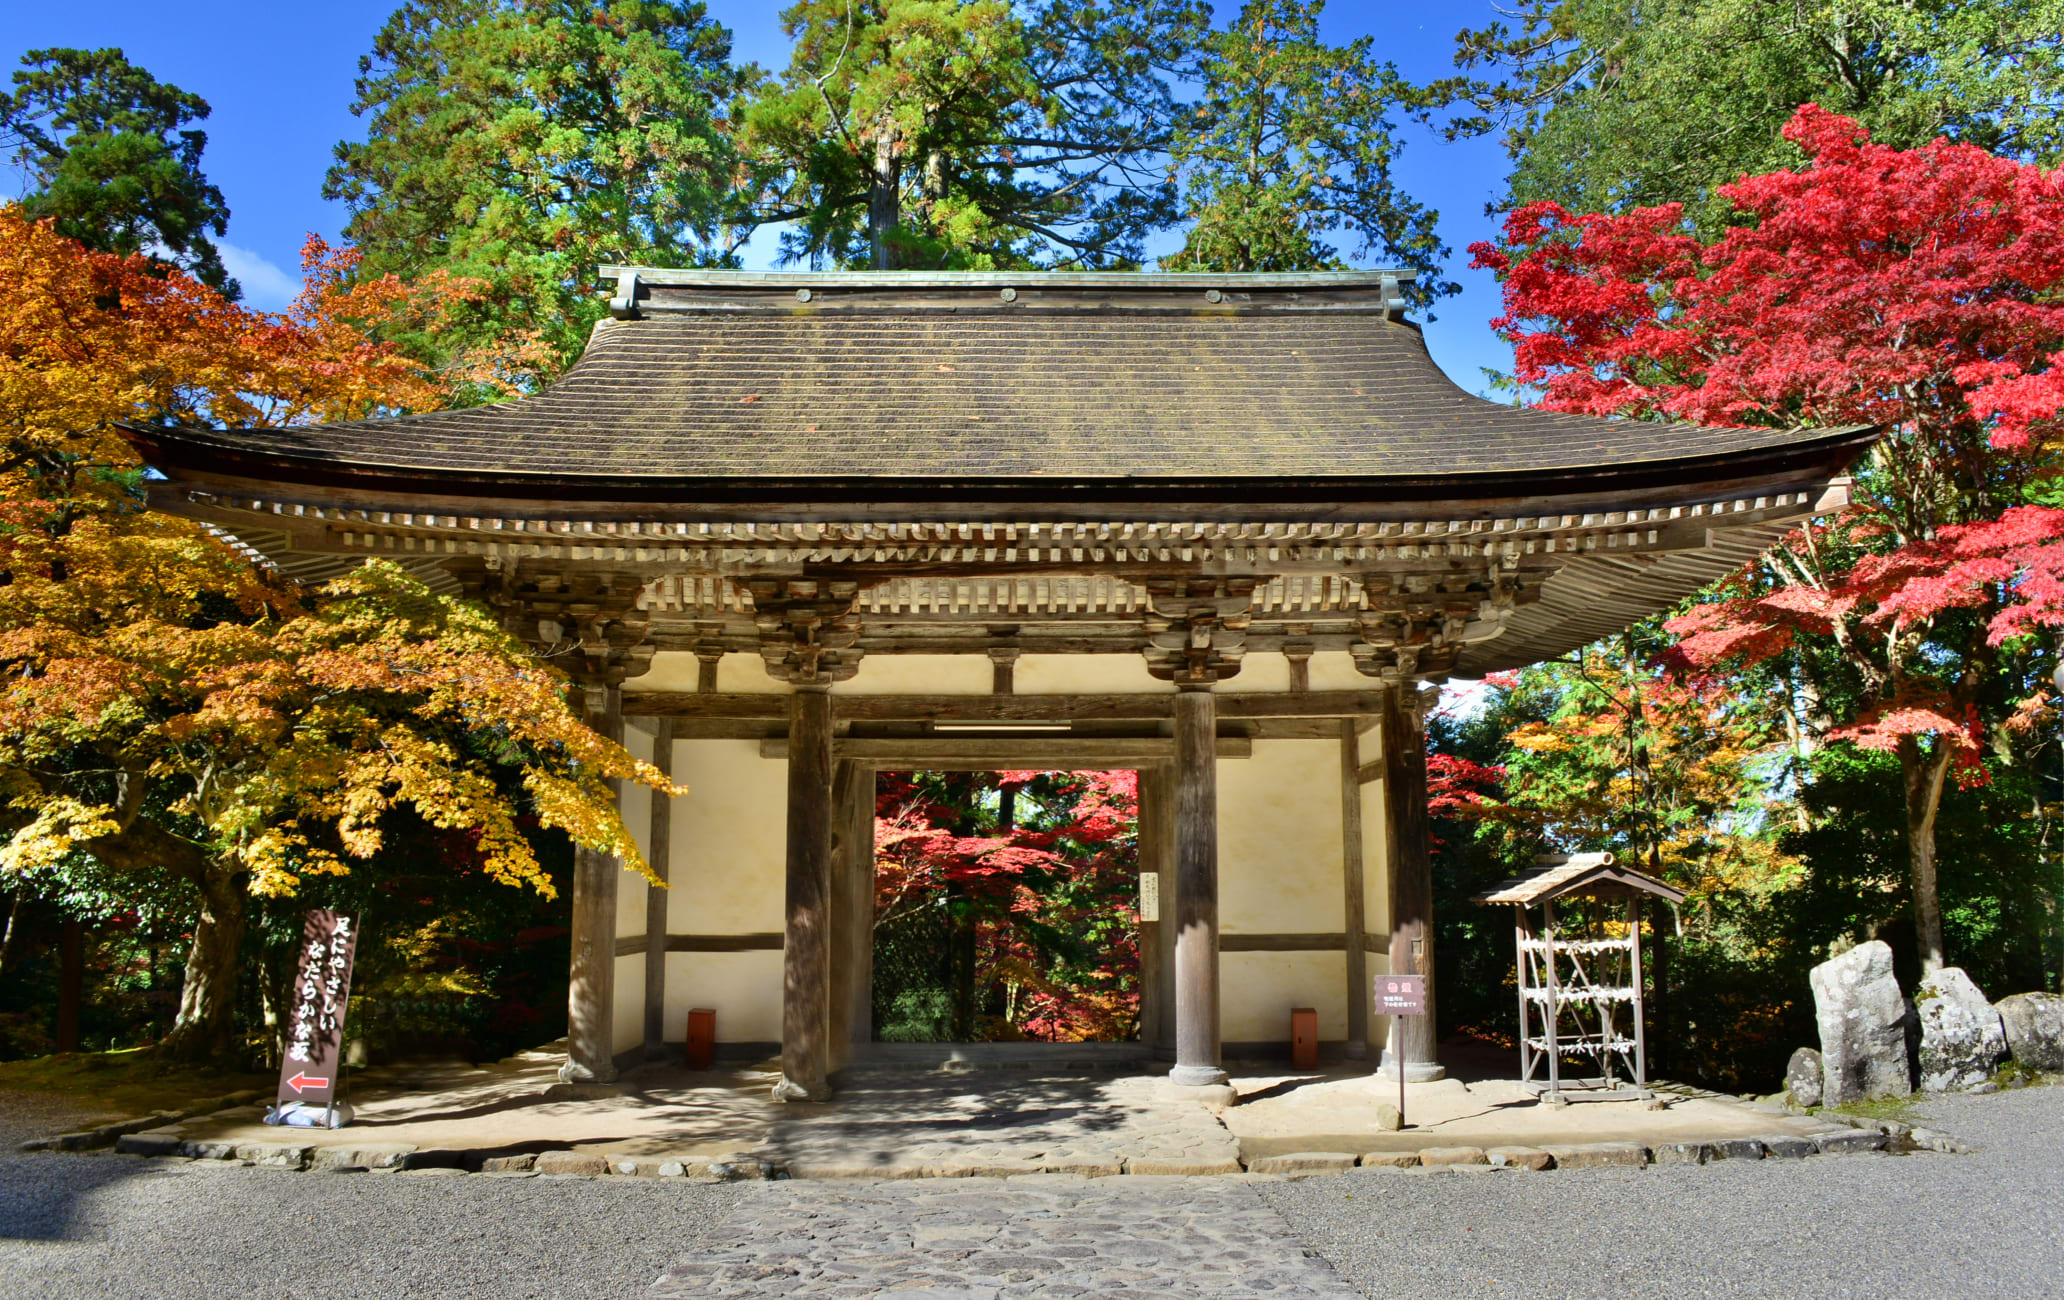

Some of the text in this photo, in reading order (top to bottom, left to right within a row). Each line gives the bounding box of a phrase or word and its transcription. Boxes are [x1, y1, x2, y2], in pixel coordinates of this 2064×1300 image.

[289, 940, 325, 1063] なだらかな坂
[319, 916, 351, 1031] 足にやさしい
